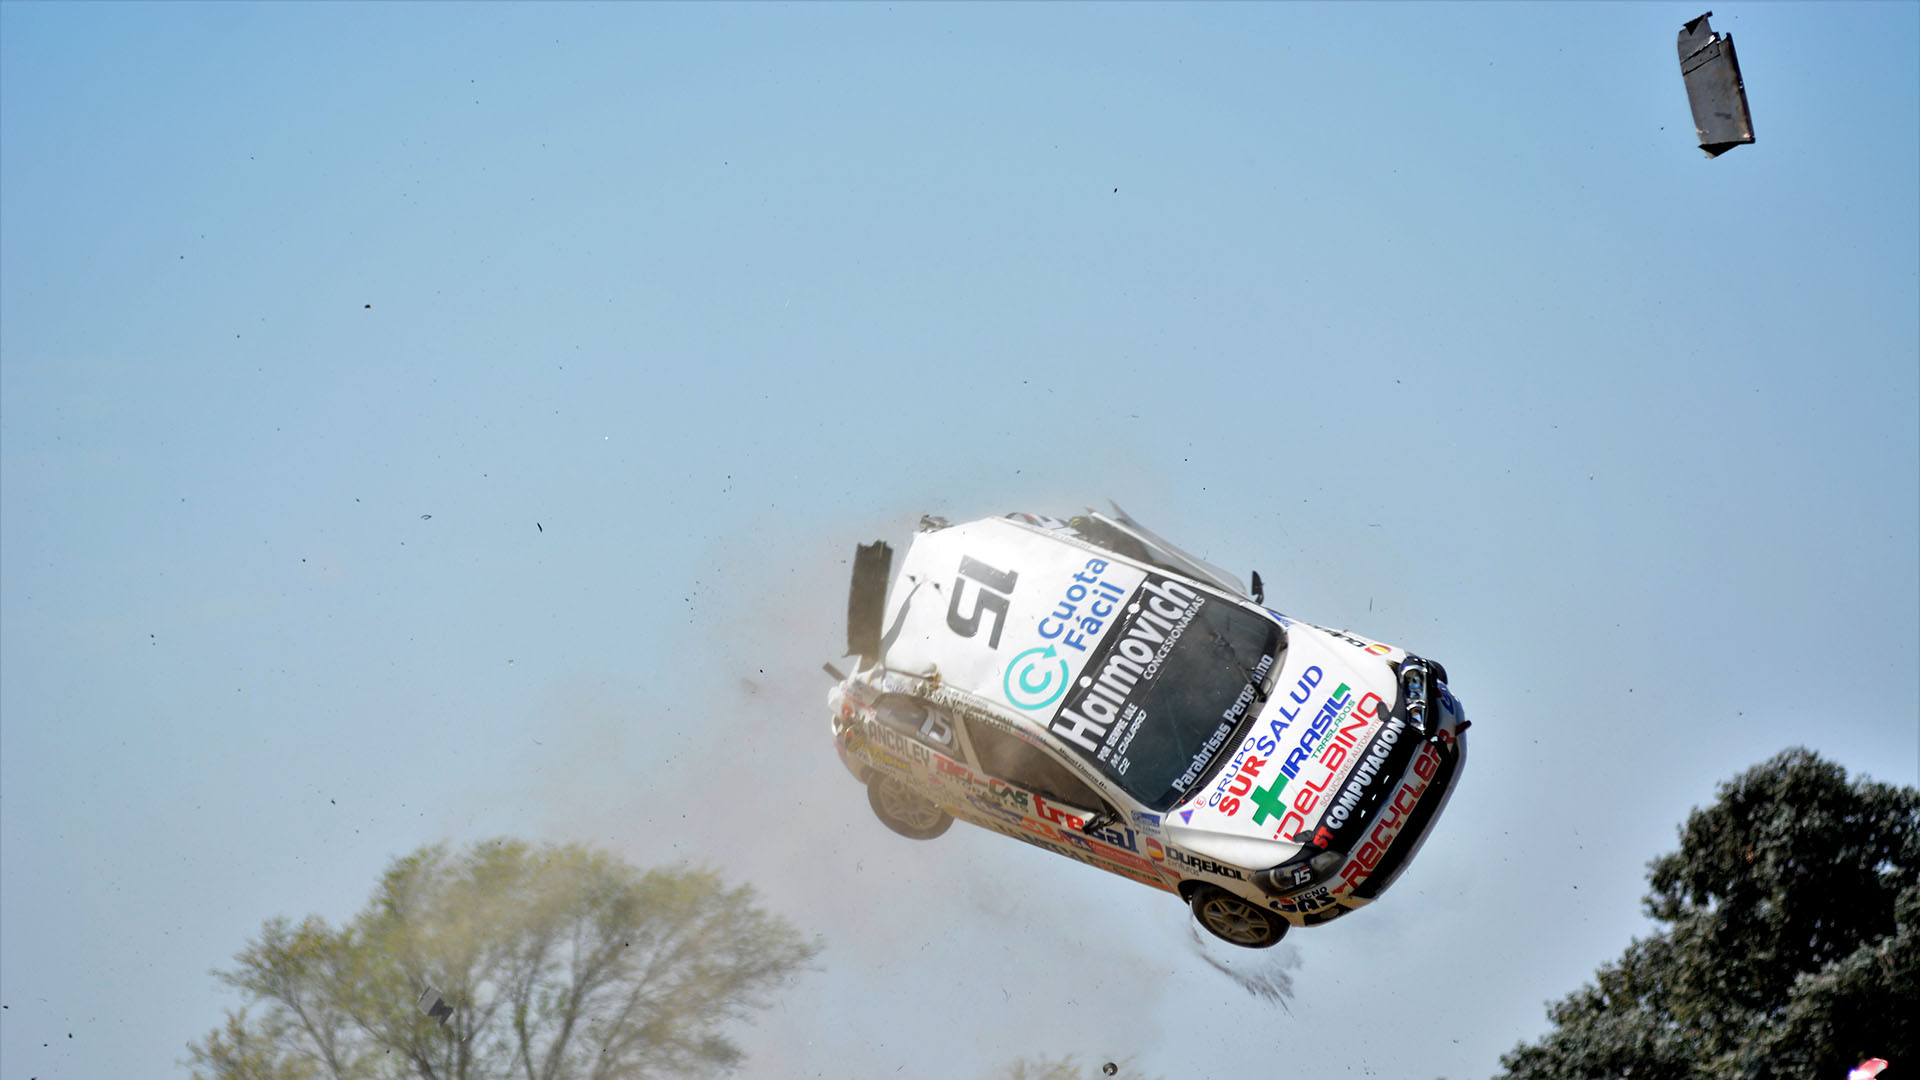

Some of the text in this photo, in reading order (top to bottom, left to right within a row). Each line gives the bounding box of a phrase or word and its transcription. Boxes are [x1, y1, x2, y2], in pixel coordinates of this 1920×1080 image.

[947, 554, 1018, 650] 15
[1038, 558, 1109, 639] Cuota
[1063, 581, 1126, 652] Fácil
[1051, 579, 1197, 752] Haimovich
[1143, 596, 1205, 680] CONCESIONARIAS
[919, 705, 951, 744] 15
[1171, 723, 1231, 793] Parabrisas
[1281, 688, 1351, 780] IRASIL
[1311, 700, 1356, 759] TRASLADOS
[1209, 737, 1256, 807] GRUPO
[1313, 716, 1406, 850] ST COMPUTACION
[1320, 758, 1353, 808] SOLUCIONES
[1165, 846, 1248, 882] DUREKOL
[1292, 886, 1328, 902] TECNO
[1294, 867, 1312, 884] 15
